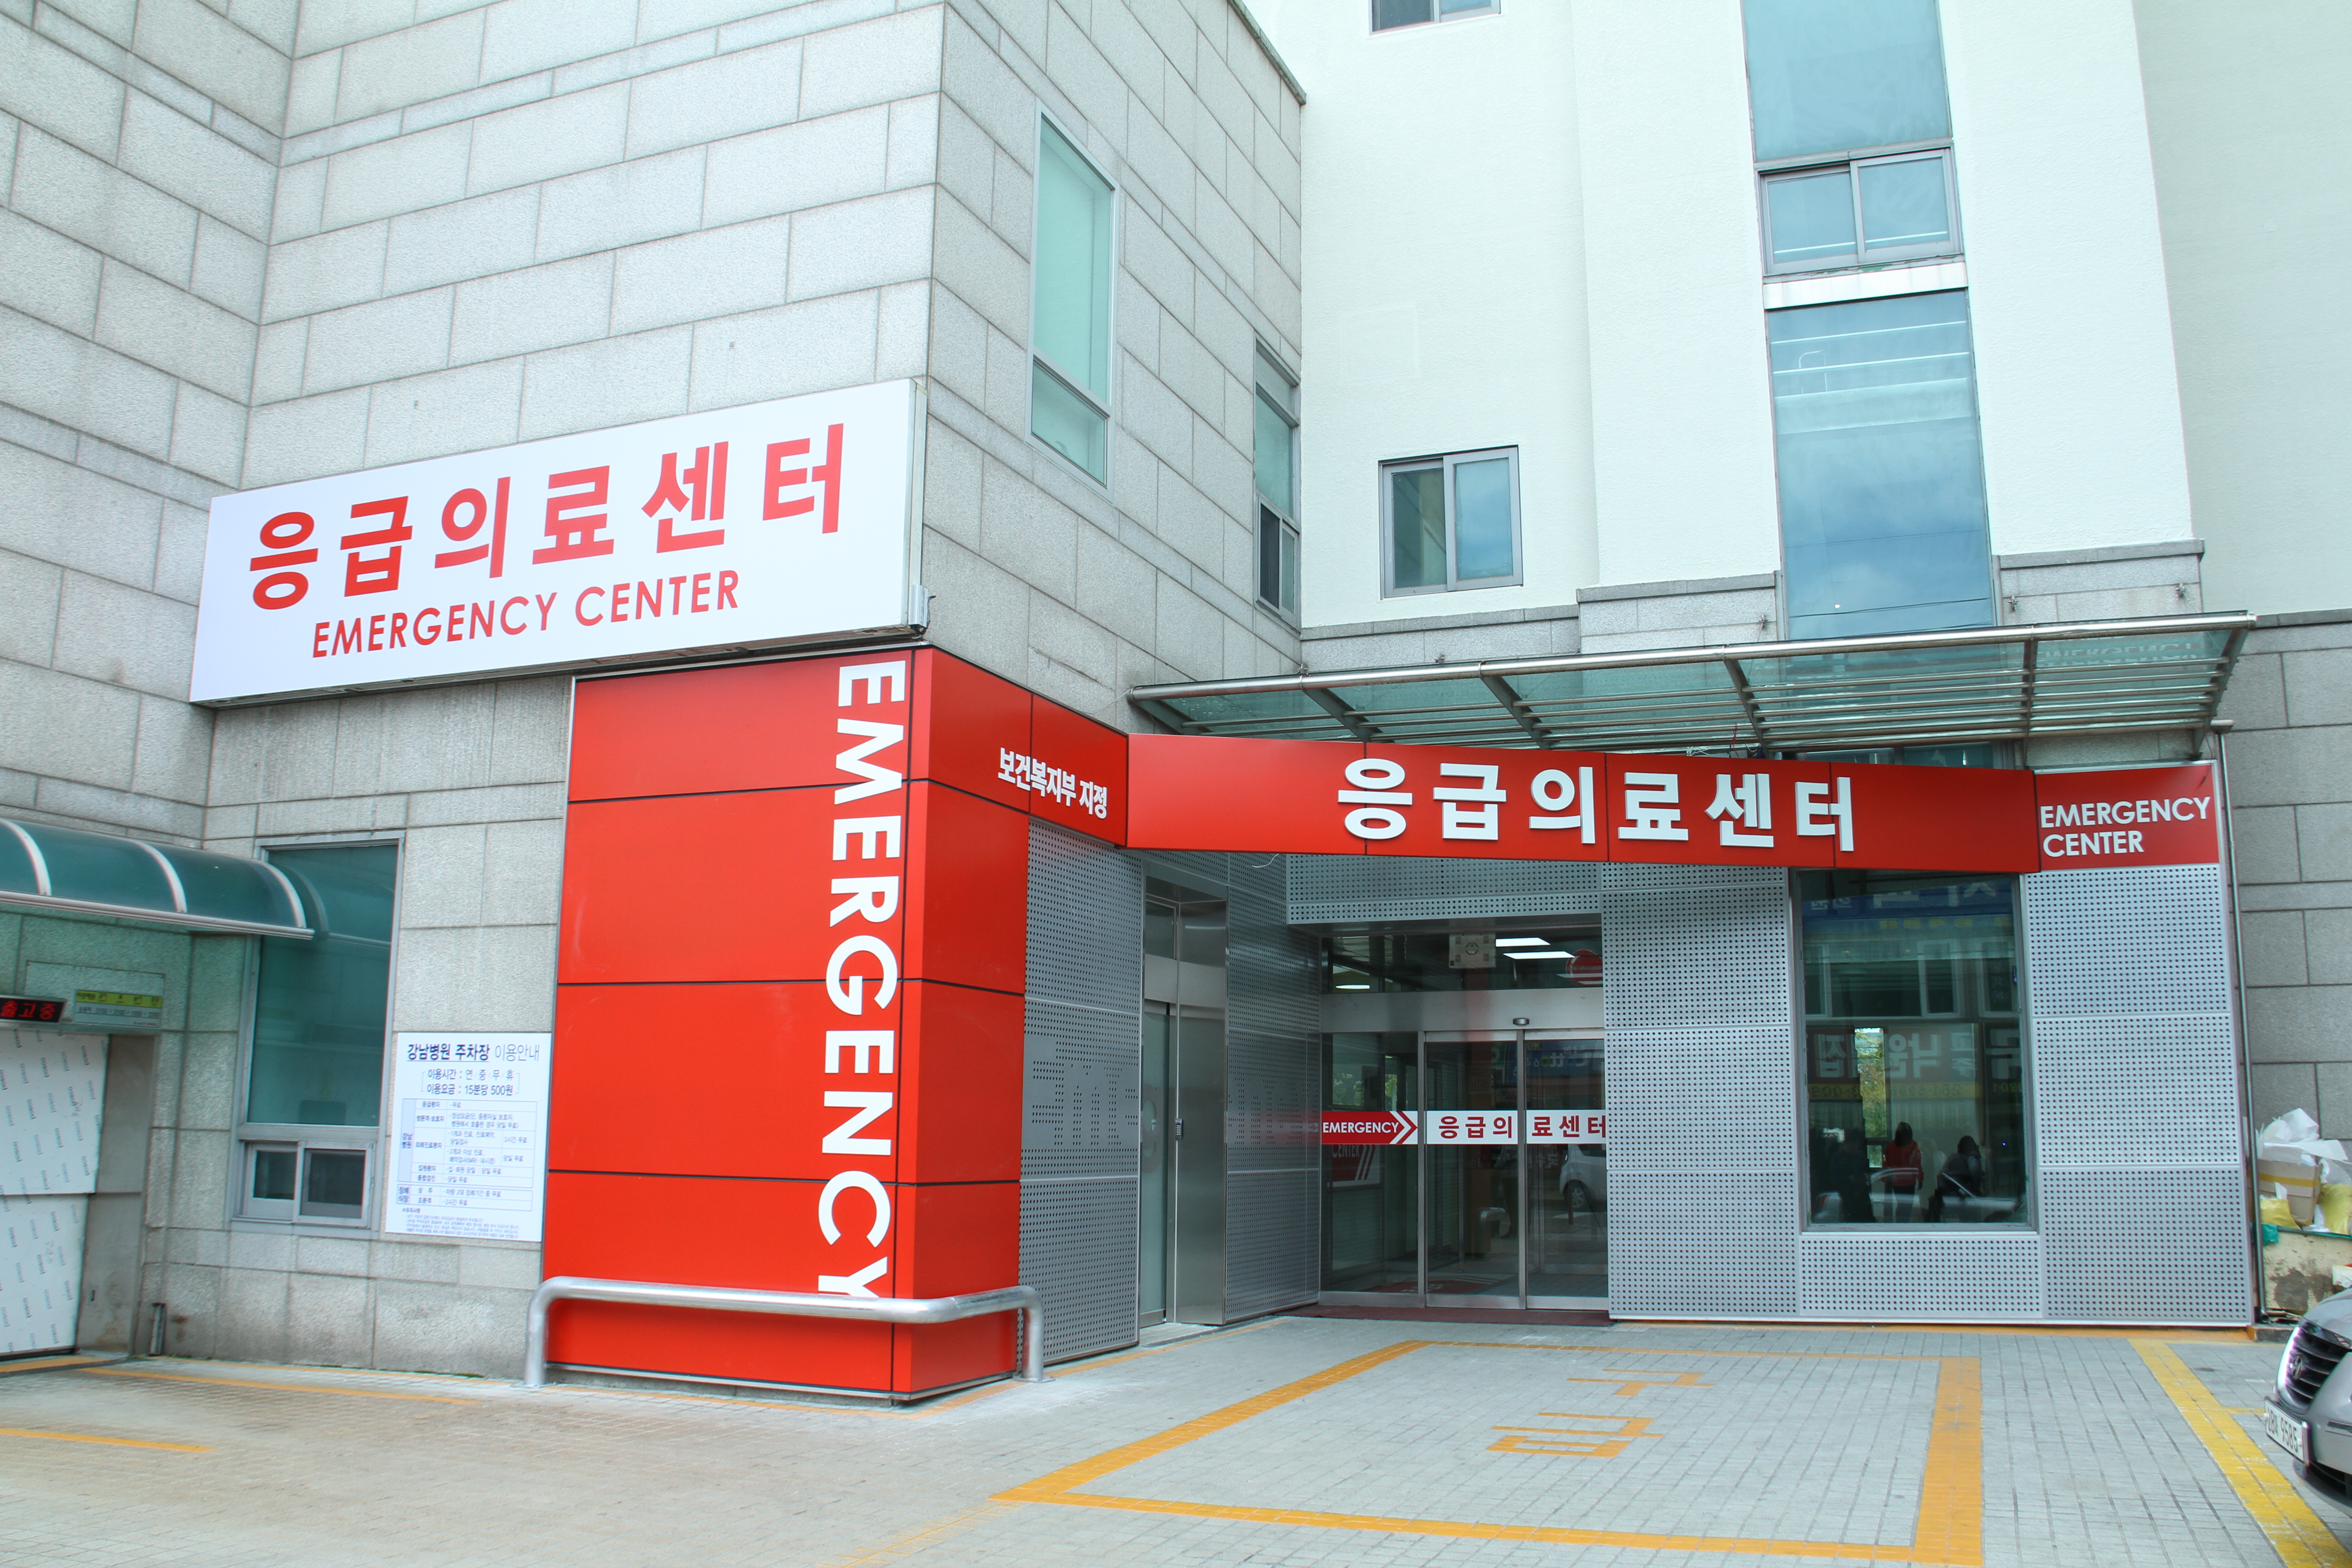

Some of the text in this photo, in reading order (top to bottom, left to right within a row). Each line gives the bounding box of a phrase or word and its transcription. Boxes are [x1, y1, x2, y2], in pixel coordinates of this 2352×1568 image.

[251, 424, 843, 609] 응급의료센터
[314, 571, 737, 657] EMERGENCY CENTER
[998, 748, 1107, 818] 보건복지부 지정
[1338, 758, 1853, 851] 응급의료센터
[2041, 796, 2211, 828] EMERGENCY
[2043, 831, 2144, 857] CENTER
[818, 660, 906, 1298] EMERGENCY
[1, 1001, 57, 1020] 출고중
[407, 1043, 540, 1062] 강남병원 주차장 이용안내
[427, 1083, 456, 1095] 이용요금
[465, 1084, 488, 1096] 15분당
[491, 1084, 513, 1096] 500원
[428, 1068, 457, 1080] 이용시간
[1323, 1121, 1399, 1133] EMERGENCY
[2280, 1417, 2298, 1453] 9585
